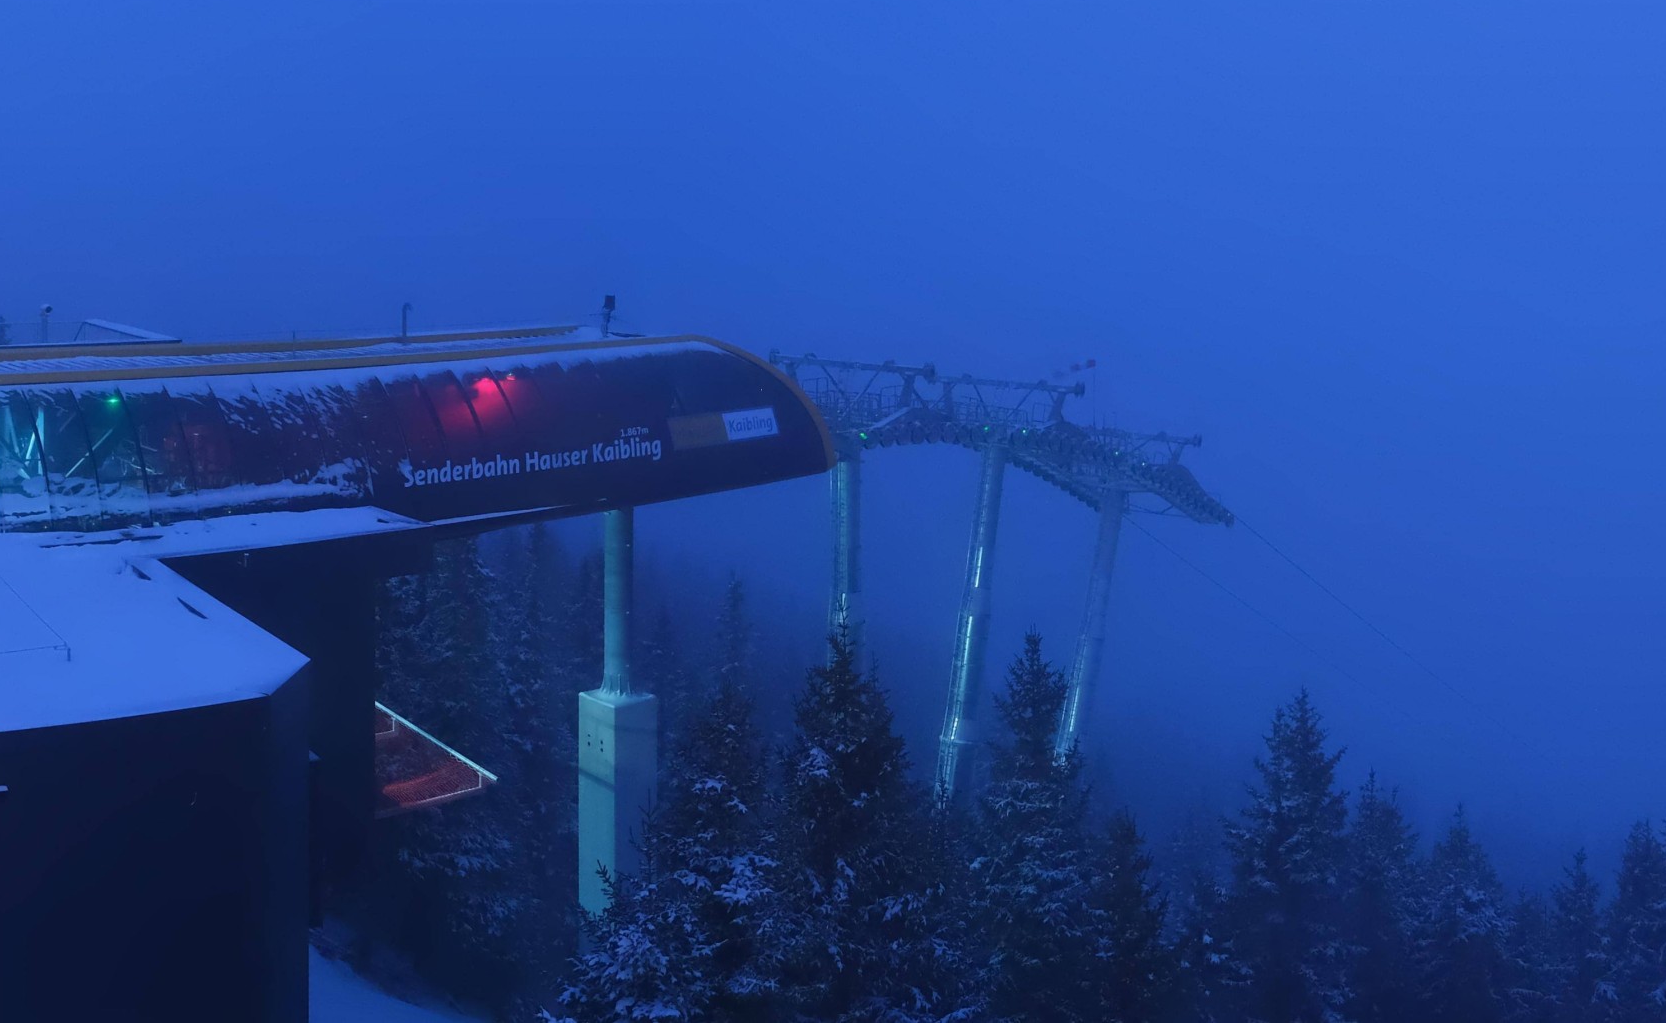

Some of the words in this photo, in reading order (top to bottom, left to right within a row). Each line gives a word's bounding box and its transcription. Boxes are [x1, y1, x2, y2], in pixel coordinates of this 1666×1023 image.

[620, 426, 649, 438] 1.867m
[728, 415, 774, 433] Kaibling
[403, 454, 521, 488] Senderbahn
[525, 448, 588, 473] Hauser
[593, 436, 662, 464] Kaibling
